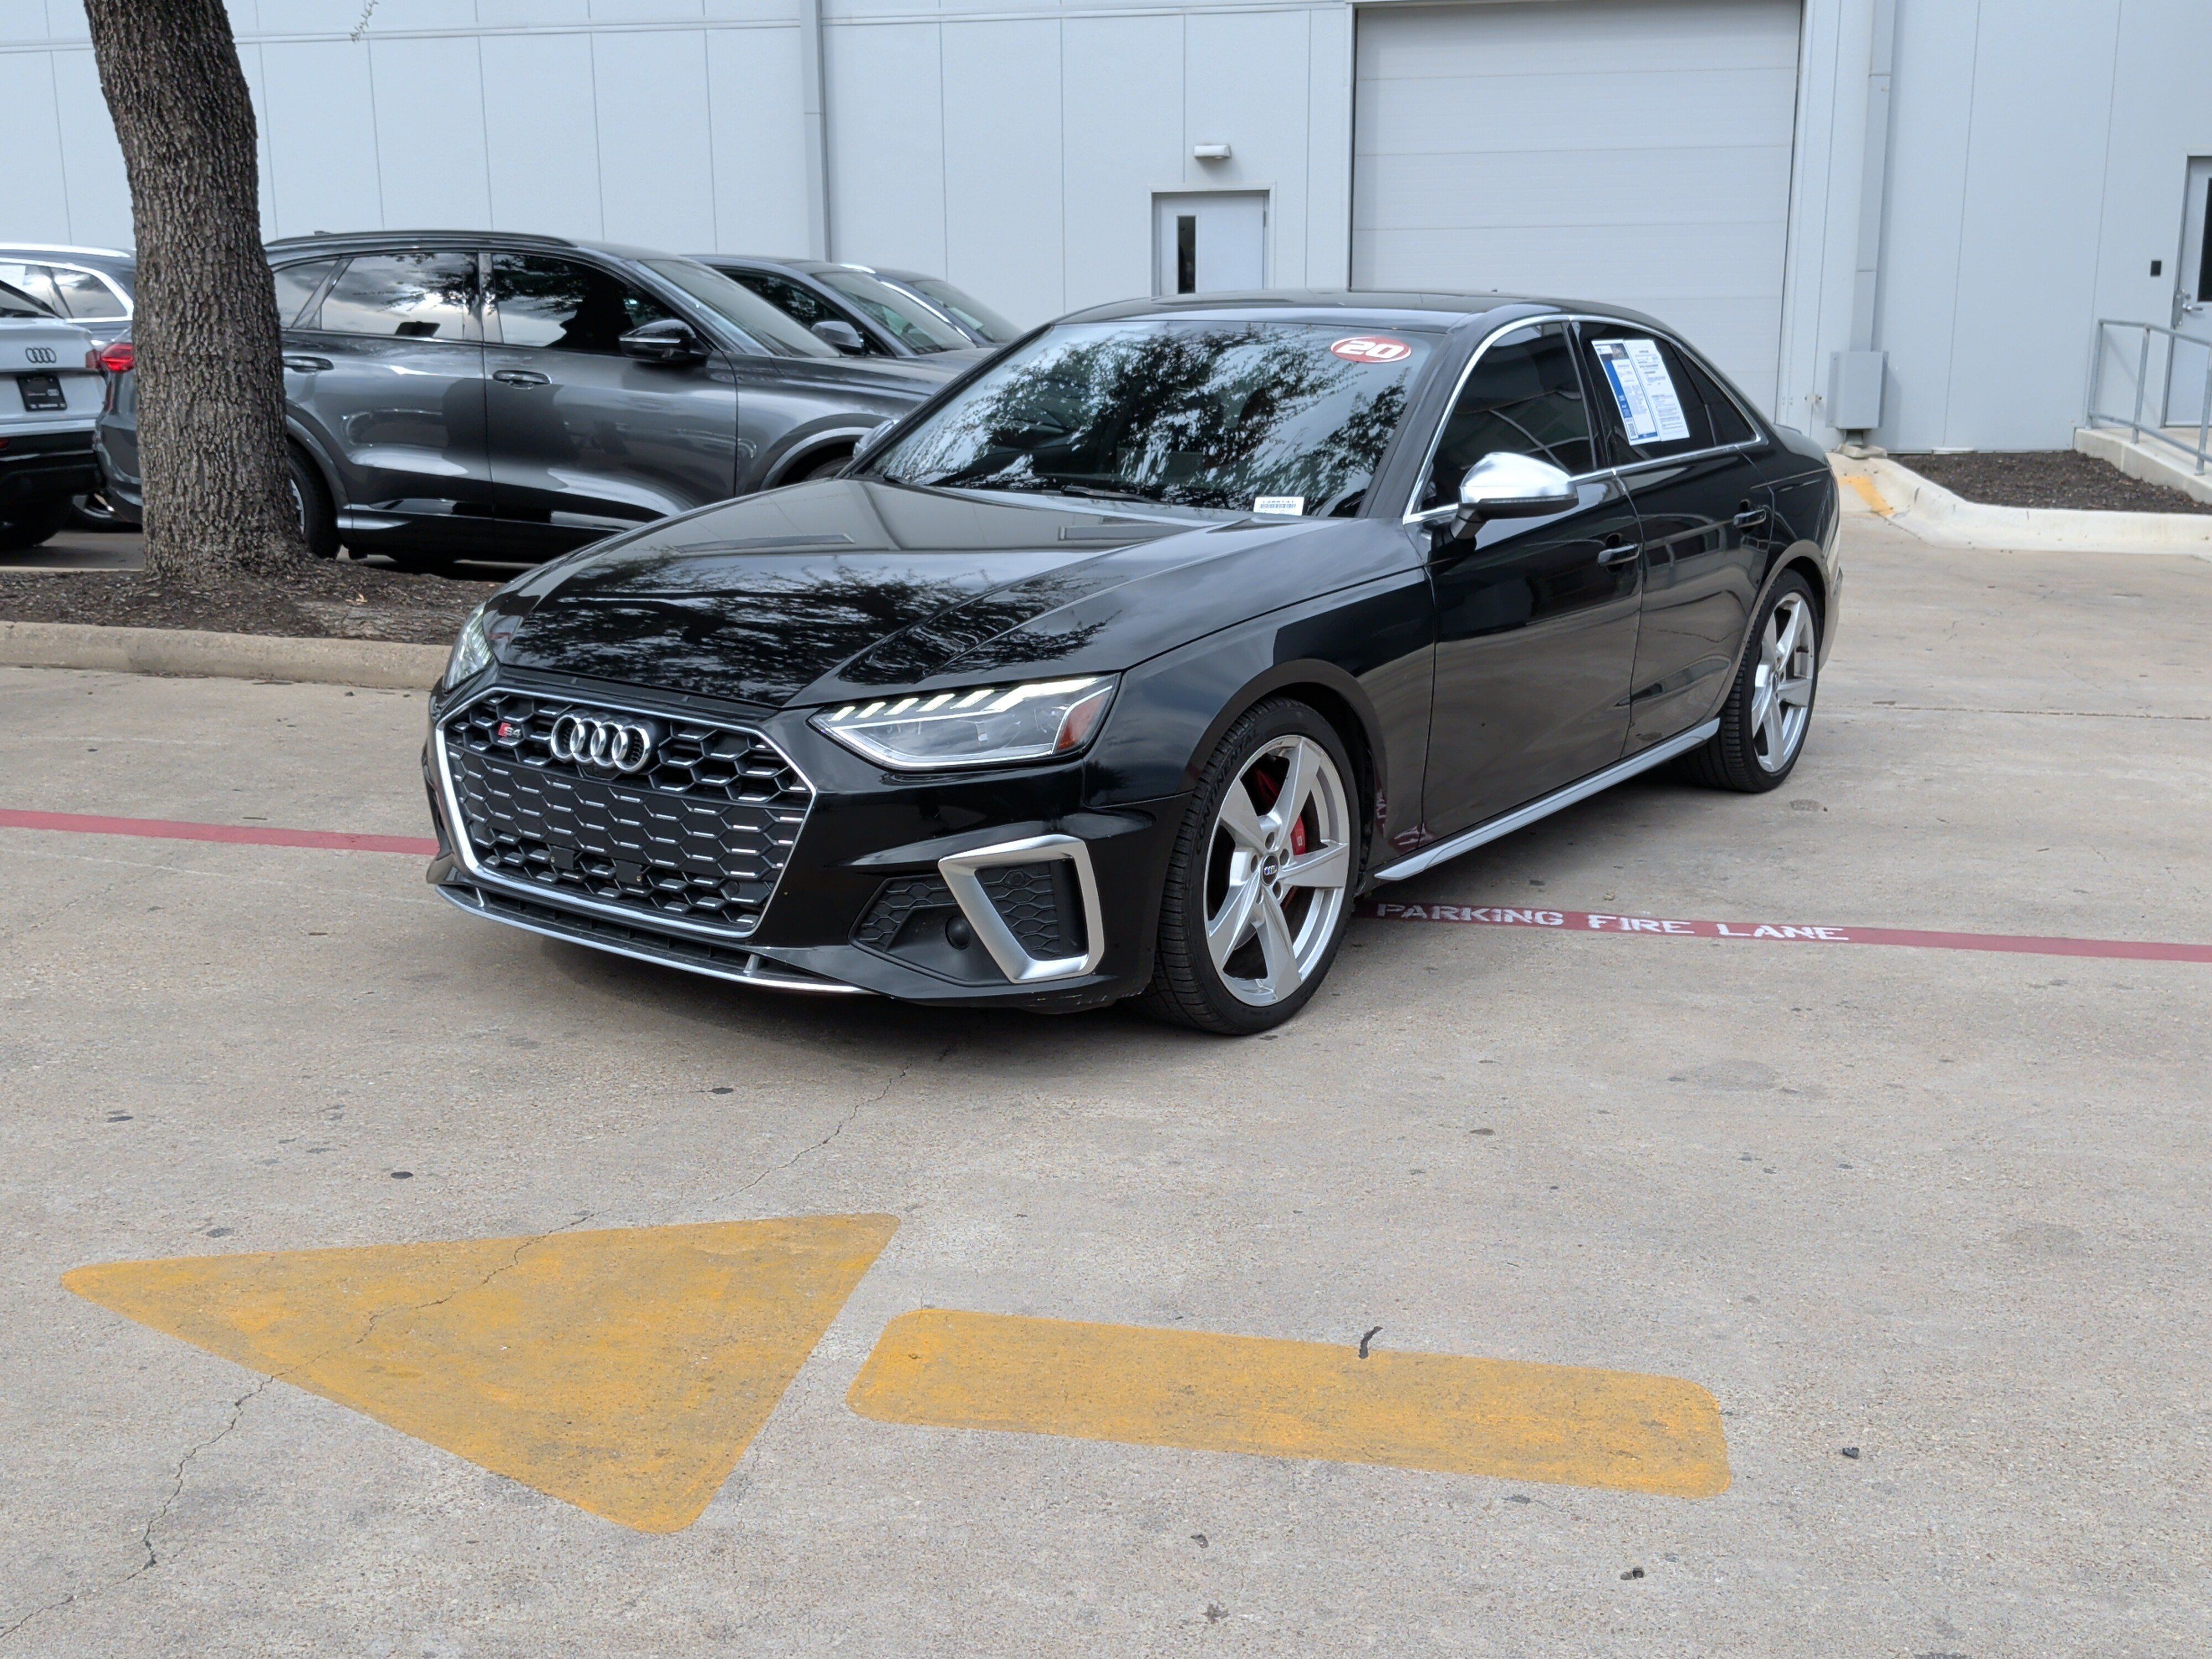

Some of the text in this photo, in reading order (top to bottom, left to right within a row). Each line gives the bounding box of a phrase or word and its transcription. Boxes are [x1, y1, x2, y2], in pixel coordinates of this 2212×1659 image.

[1335, 340, 1404, 358] 20
[502, 725, 521, 738] S4
[1377, 904, 1849, 941] PARKING FIRE LANE
